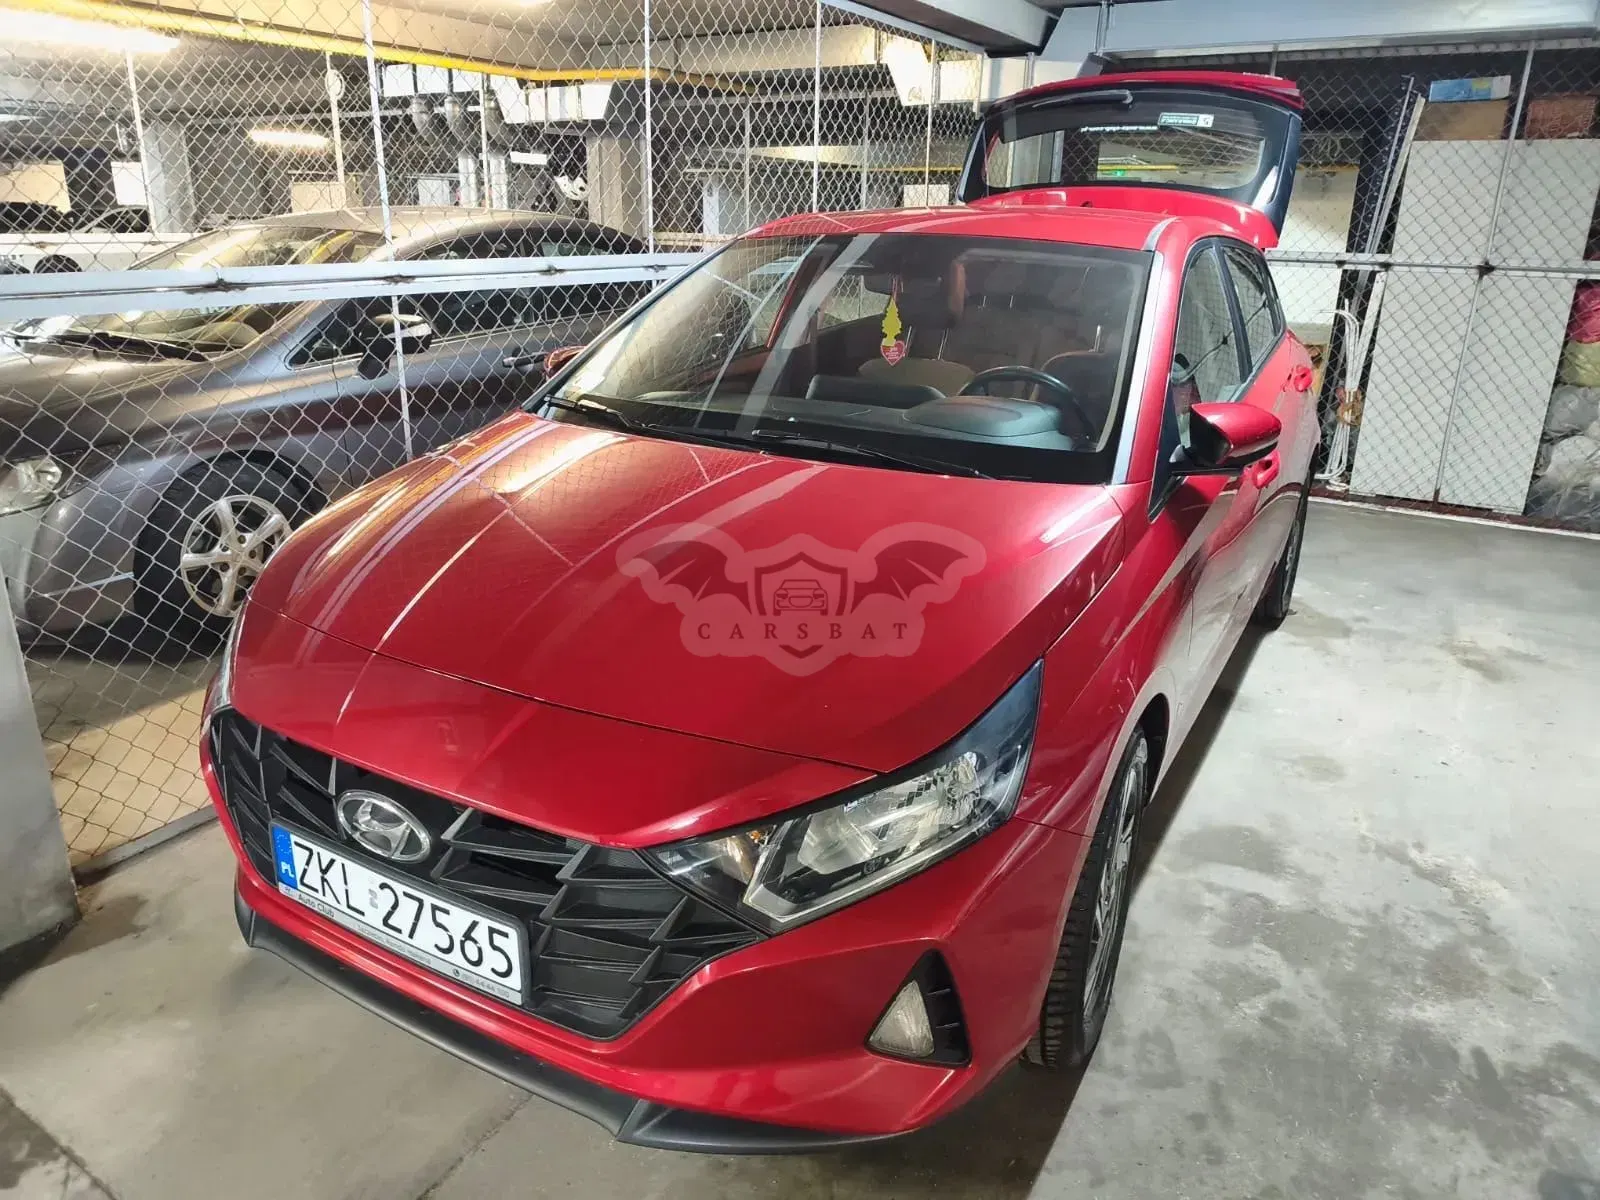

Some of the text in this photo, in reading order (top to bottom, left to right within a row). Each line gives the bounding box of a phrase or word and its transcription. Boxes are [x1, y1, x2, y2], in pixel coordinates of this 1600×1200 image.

[280, 860, 295, 878] PL
[293, 840, 366, 918] ZKL
[378, 881, 514, 979] 27565
[298, 893, 335, 918] Auto Club
